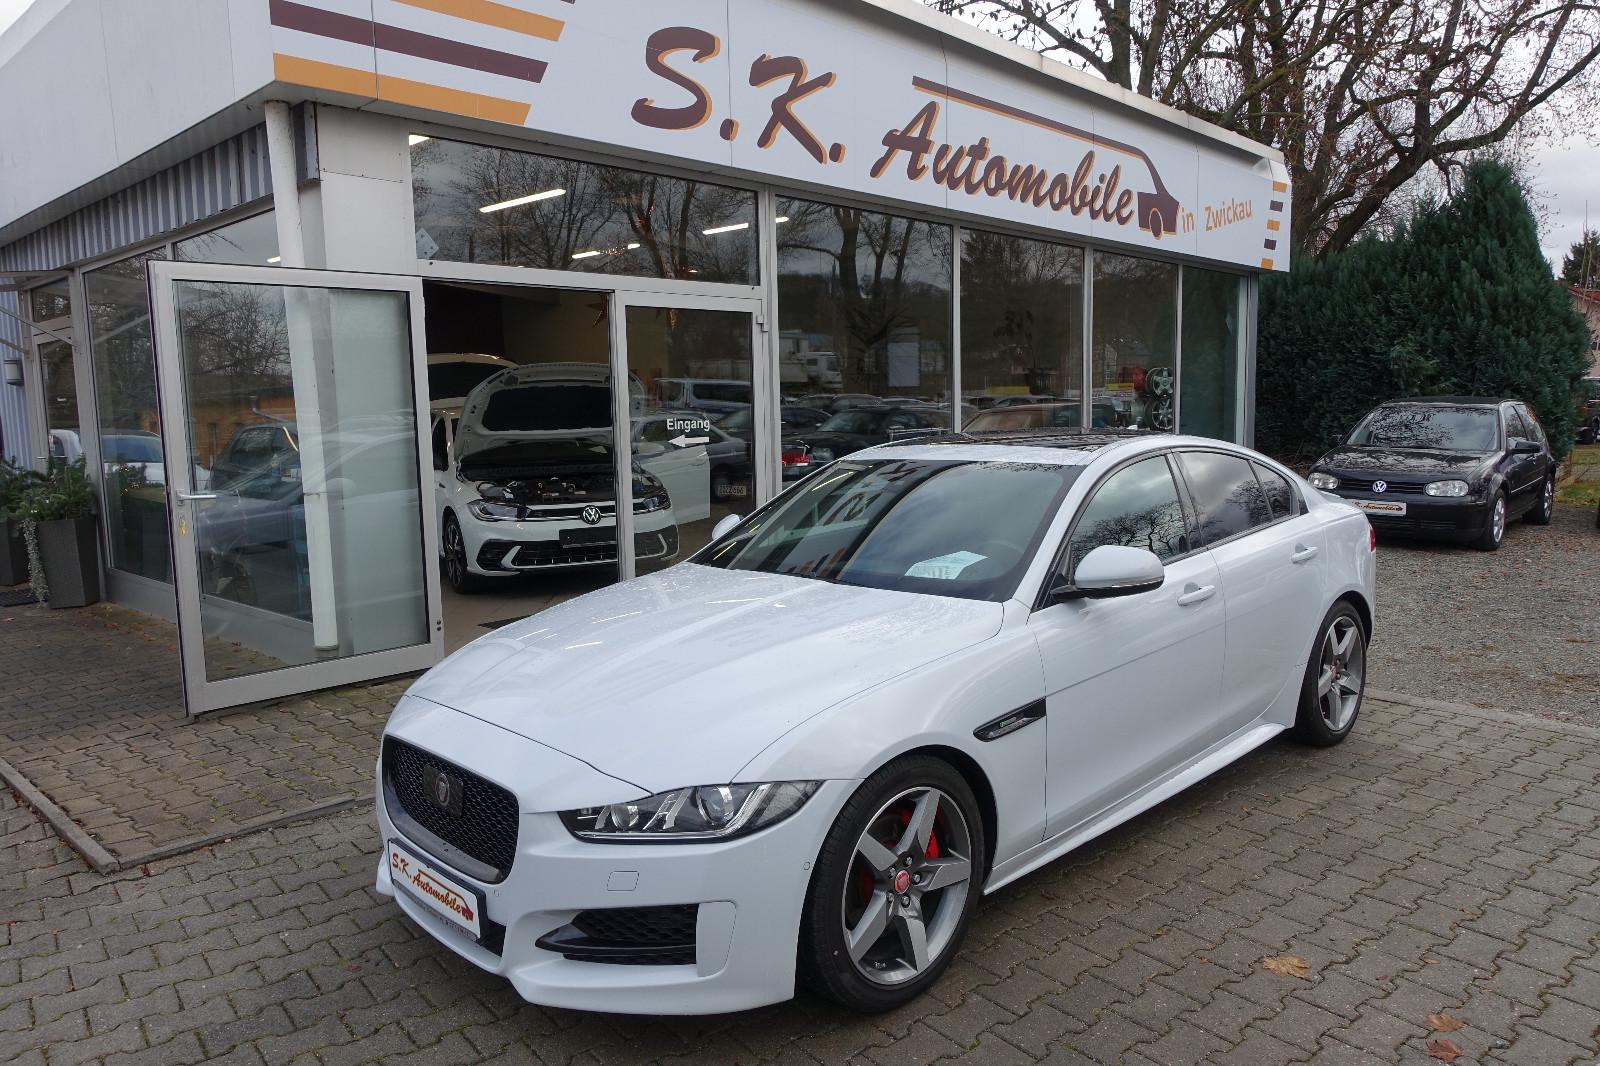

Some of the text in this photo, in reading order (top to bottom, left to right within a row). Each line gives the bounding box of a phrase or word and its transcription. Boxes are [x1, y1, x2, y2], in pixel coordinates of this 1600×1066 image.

[631, 26, 1252, 234] S.K. Automobile in Zwickau
[666, 418, 710, 432] Eingang
[392, 853, 461, 914] S.K. Automobile
